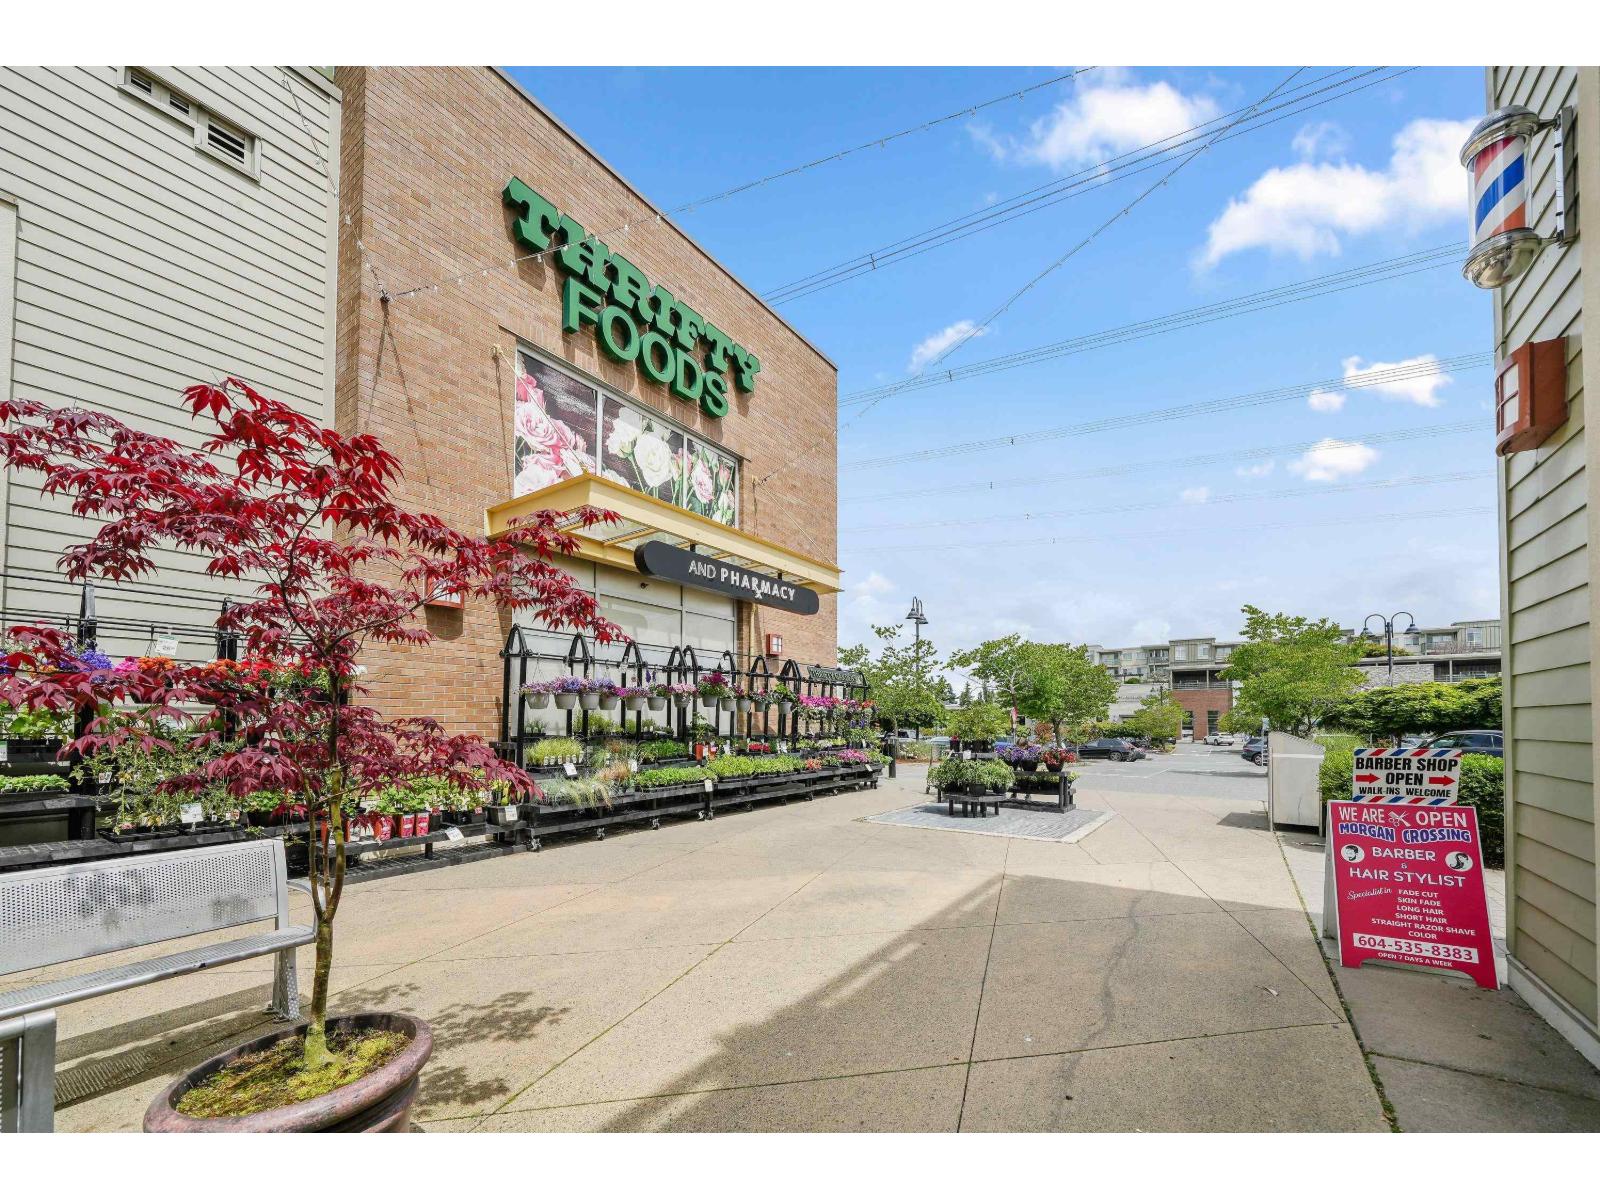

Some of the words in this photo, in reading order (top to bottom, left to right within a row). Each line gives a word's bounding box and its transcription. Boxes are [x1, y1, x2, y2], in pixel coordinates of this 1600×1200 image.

[502, 176, 760, 393] THRIFTY
[563, 276, 729, 418] FOODS
[688, 560, 716, 579] AND
[720, 567, 796, 600] PHARMACY
[1356, 757, 1411, 771] BARBER
[1417, 758, 1458, 772] SHOP
[1385, 772, 1424, 786] OPEN
[1359, 786, 1400, 796] WALK-INS
[1405, 788, 1451, 798] WELCOME
[1339, 806, 1358, 822] WE
[1361, 807, 1385, 823] ARE
[1415, 811, 1467, 828] OPEN
[1338, 822, 1395, 842] MORGAN
[1402, 828, 1472, 844] CROSSING
[1372, 847, 1436, 861] BARBER
[1350, 867, 1389, 881] HAIR
[1394, 871, 1466, 888] STYLIST
[1398, 888, 1420, 896] FADE
[1397, 896, 1417, 904] SKIN
[1419, 899, 1441, 907] FADE
[1396, 905, 1420, 913] LONG
[1422, 907, 1444, 915] HAIR
[1395, 912, 1423, 921] SHORT
[1425, 916, 1447, 924] HAIR
[1371, 918, 1412, 929] STRAIGHT
[1414, 923, 1444, 933] RAZOR
[1445, 926, 1476, 936] SHAVE
[1408, 930, 1437, 940] COLOR
[1358, 936, 1473, 961] 604-535-8383
[1378, 952, 1397, 960] OPEN
[1404, 955, 1424, 963] DAYS
[1432, 958, 1453, 967] WEEK
